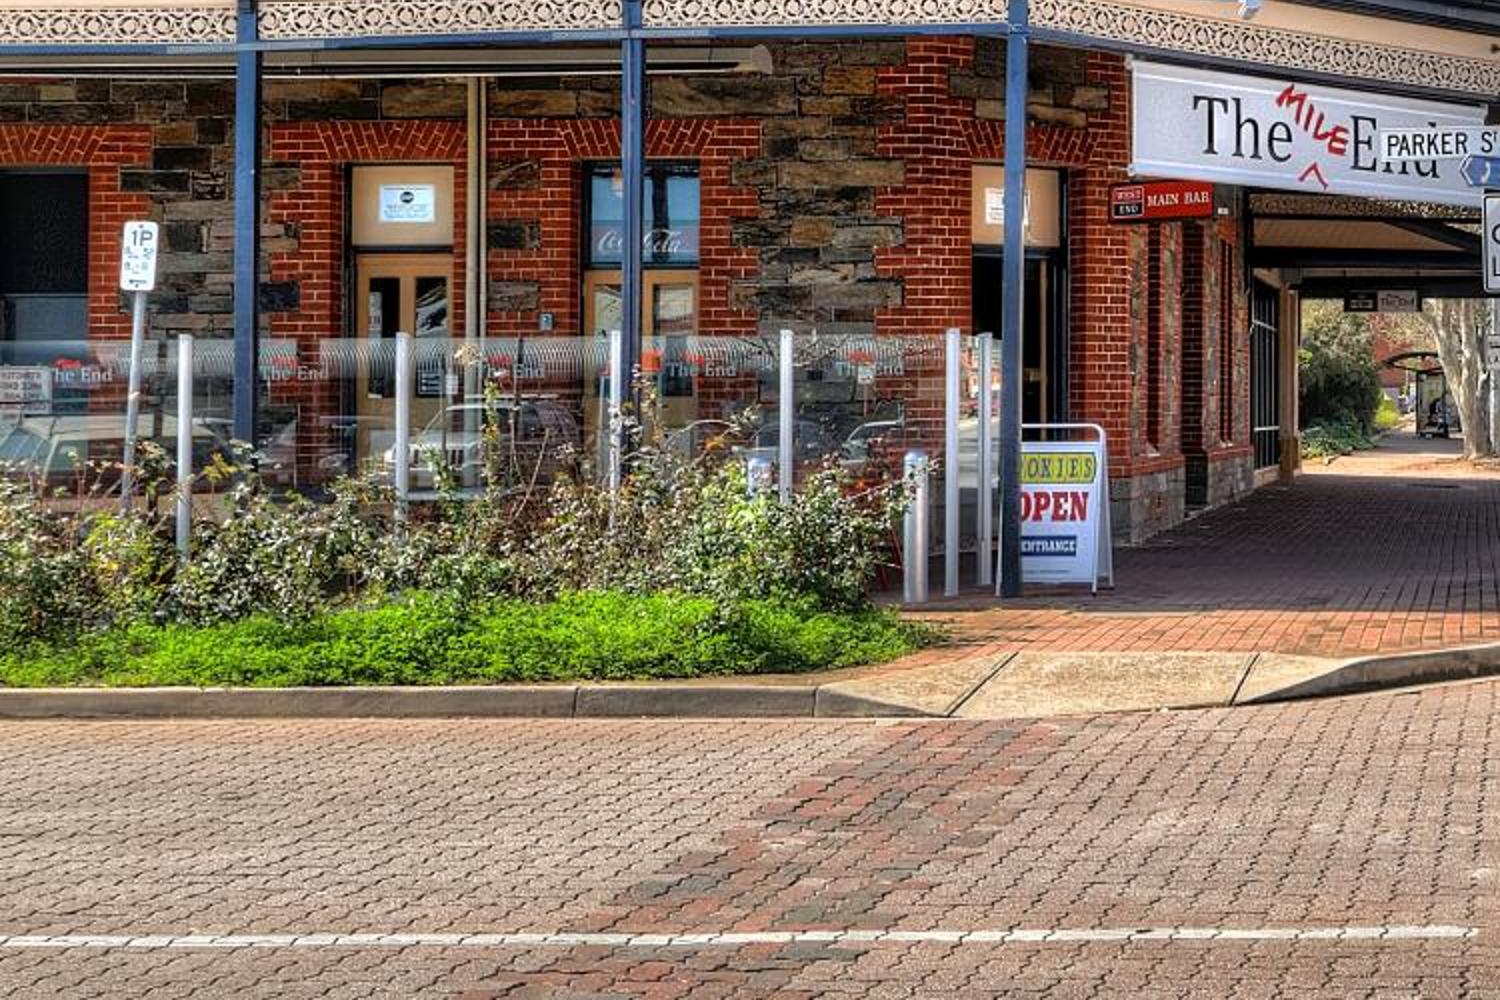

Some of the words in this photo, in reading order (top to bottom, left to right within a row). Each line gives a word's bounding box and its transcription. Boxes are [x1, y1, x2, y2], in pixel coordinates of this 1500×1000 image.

[1192, 94, 1293, 163] The
[1275, 83, 1350, 157] MILE
[1387, 131, 1469, 157] PARKER
[1147, 192, 1180, 208] MAIN
[1183, 190, 1210, 205] BAR
[1119, 204, 1139, 215] END
[131, 229, 153, 247] 1P
[81, 367, 113, 383] End
[1021, 456, 1094, 479] OKIES
[1021, 541, 1075, 553] ENTRANCE
